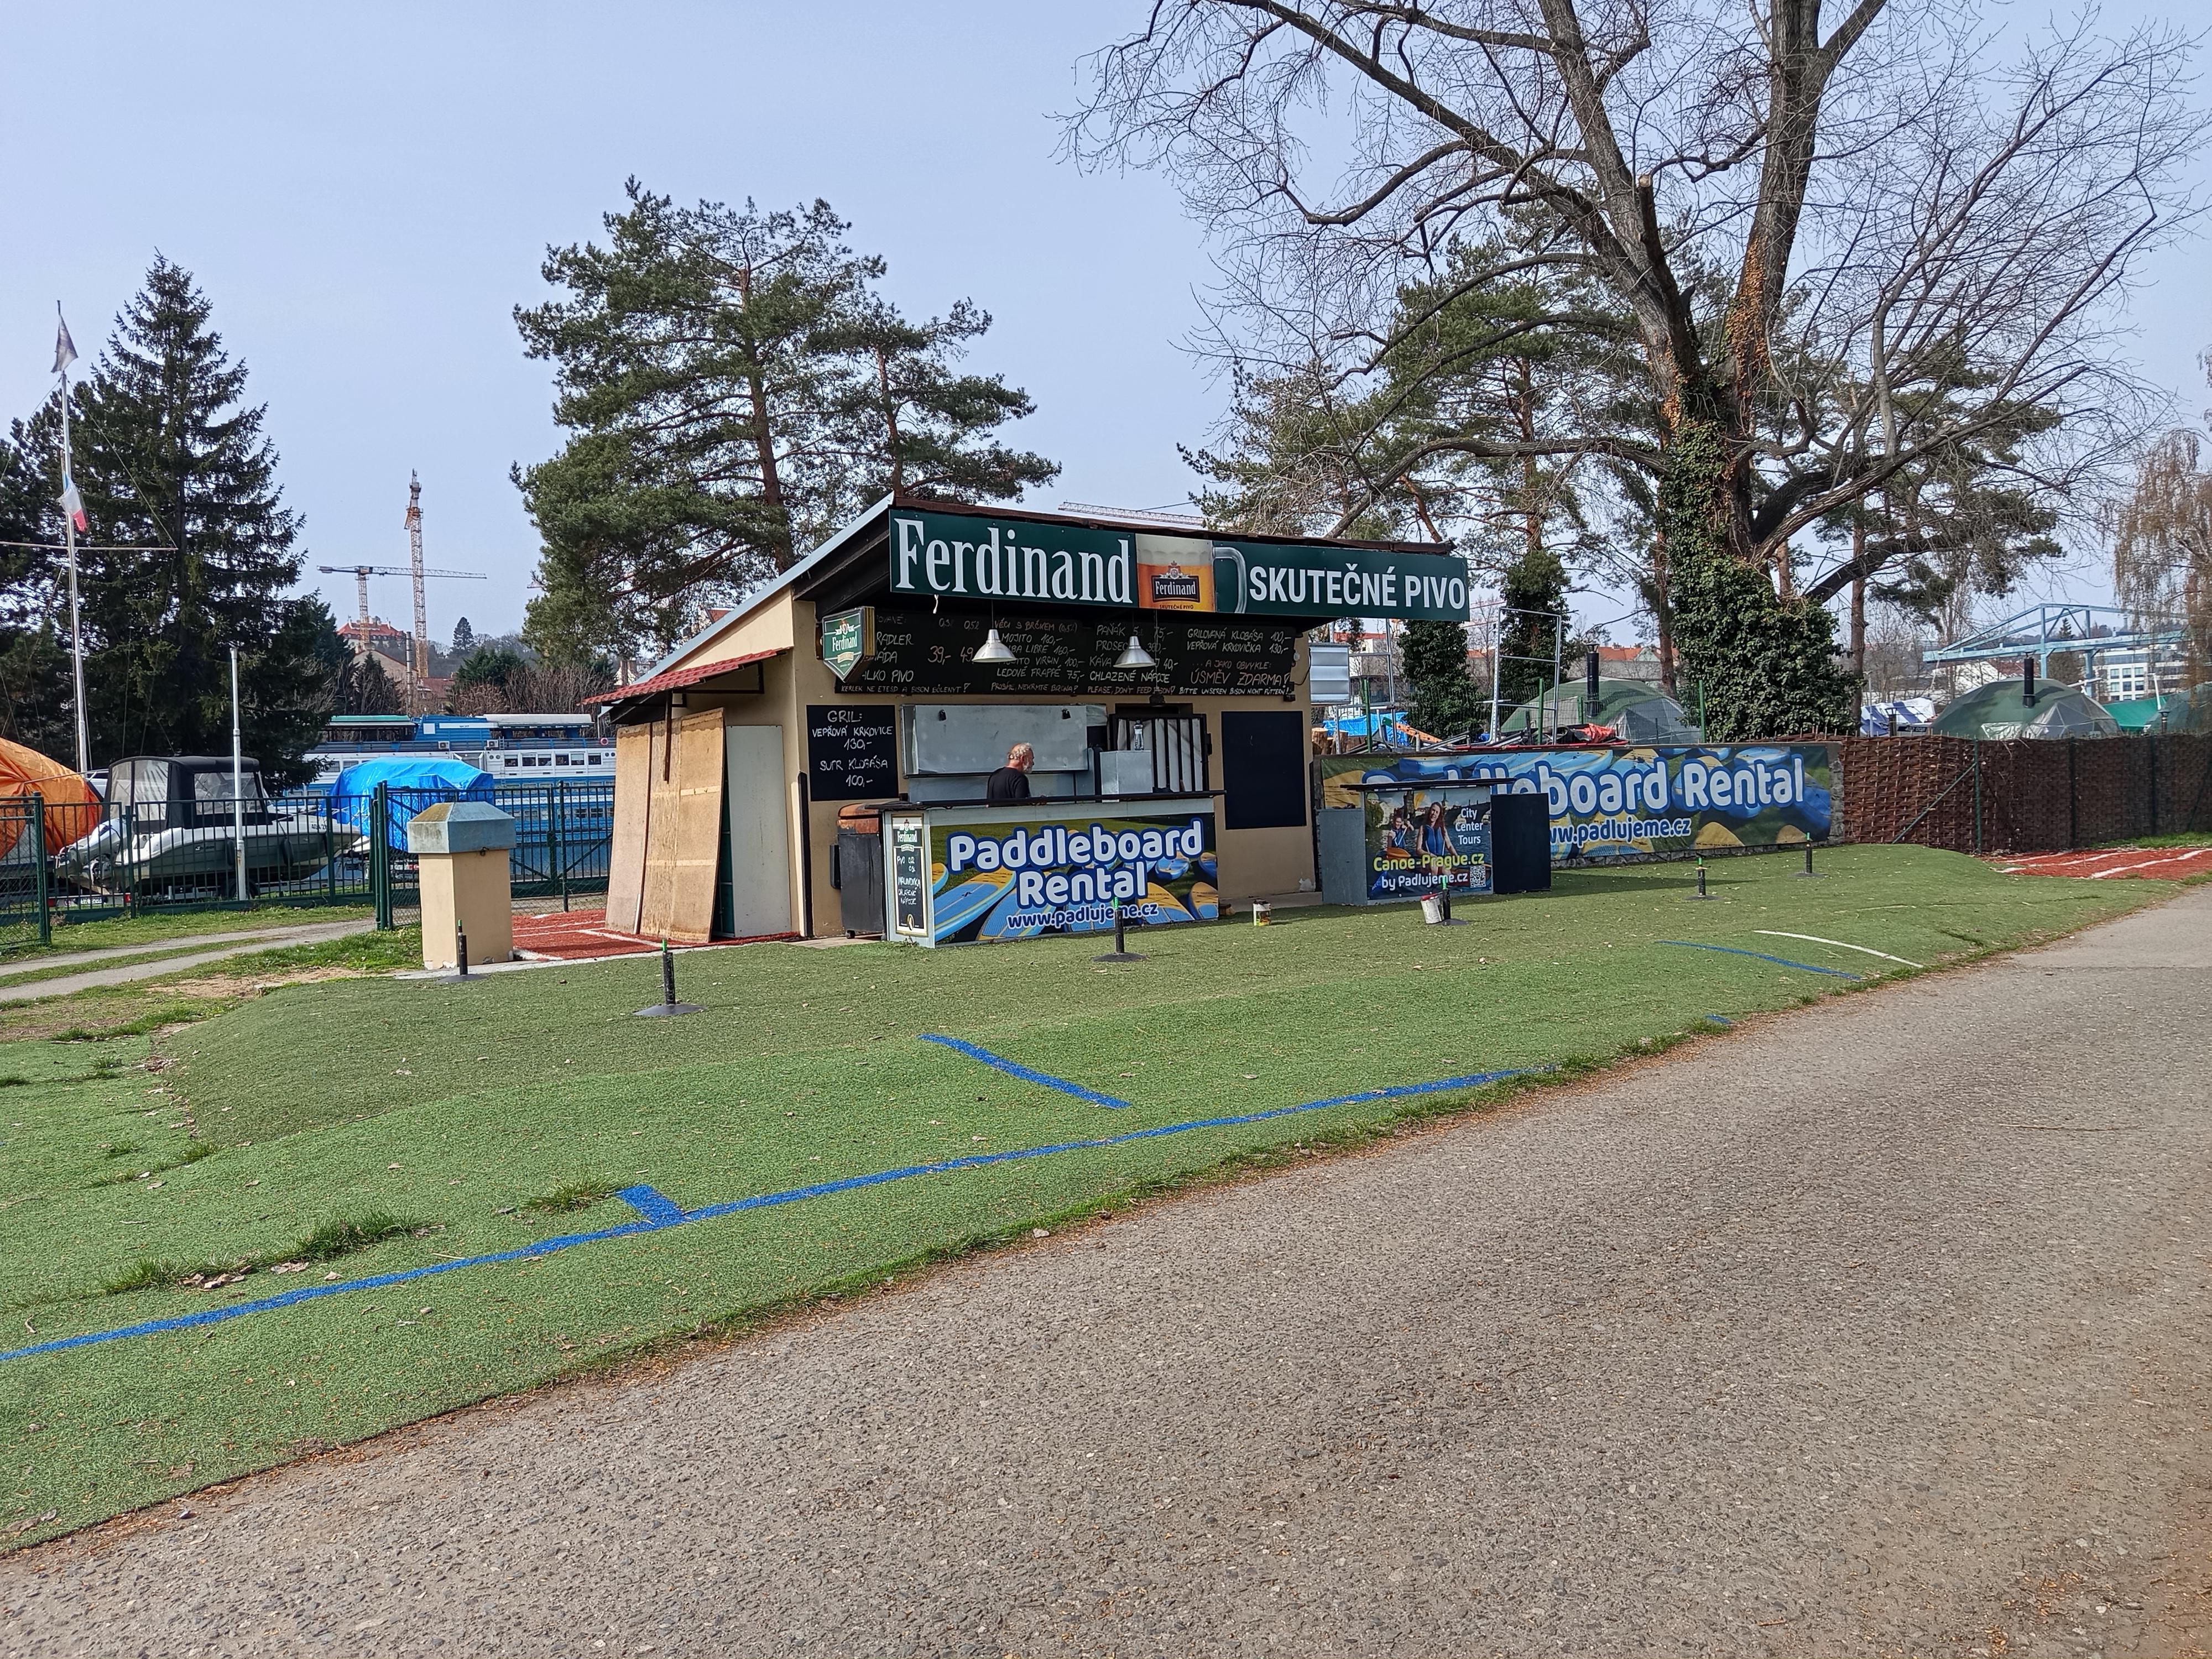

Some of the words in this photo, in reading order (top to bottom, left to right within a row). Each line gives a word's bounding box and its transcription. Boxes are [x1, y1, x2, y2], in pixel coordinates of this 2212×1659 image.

[894, 518, 1133, 603] Ferdinand
[1155, 581, 1196, 596] Ferdinand
[1249, 563, 1397, 607] SKUTEČNÉ
[1405, 575, 1465, 609] PIVO
[832, 631, 858, 652] Ferdinand
[1001, 633, 1032, 643] MOJITO
[1231, 628, 1264, 642] KLOBÁSA
[1089, 653, 1112, 667] KÁVA
[891, 669, 914, 683] PIVO
[997, 666, 1027, 677] LEDOVÉ
[1031, 665, 1062, 677] FRAPPÉ
[1089, 669, 1137, 682] CHLAZENÉ
[1191, 667, 1231, 685] ÚSMĚV
[1178, 686, 1198, 695] BITTE
[827, 710, 863, 723] GRIL:
[812, 725, 848, 738] VEPŘOVÁ
[853, 726, 894, 738] KRKOVICE
[843, 738, 872, 750] 130,-
[1683, 757, 1804, 808] Rental
[1460, 807, 1478, 820] City
[1455, 822, 1483, 832] Center
[950, 821, 1202, 872] Paddleboard
[1458, 835, 1481, 845] Tours
[1373, 853, 1485, 872] Canoe-Prague.cz
[1019, 861, 1147, 906] Rental
[1381, 876, 1396, 890] by
